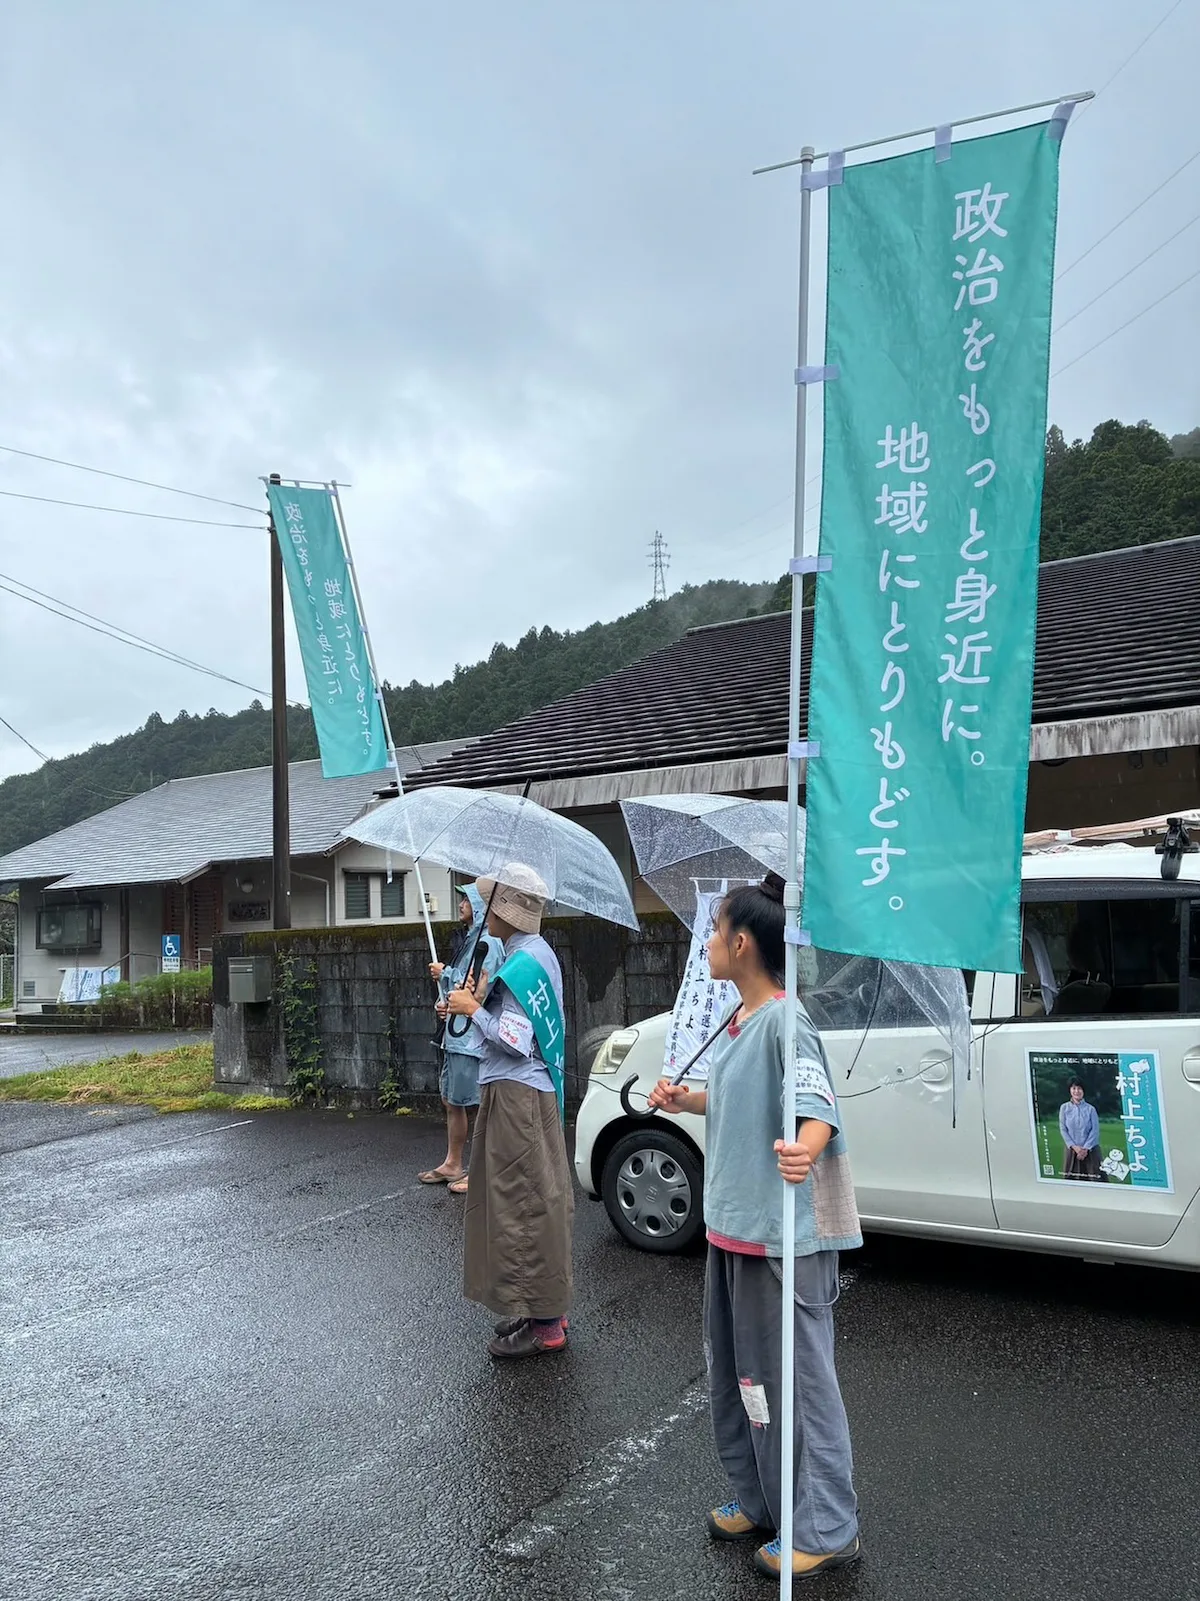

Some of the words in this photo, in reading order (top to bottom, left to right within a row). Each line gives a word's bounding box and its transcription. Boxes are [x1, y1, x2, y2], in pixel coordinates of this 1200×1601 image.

[855, 421, 931, 910] 地域にとりもどす。
[937, 182, 1009, 765] 政治をもっと身近に。
[1115, 1071, 1149, 1172] 村上ちよ
